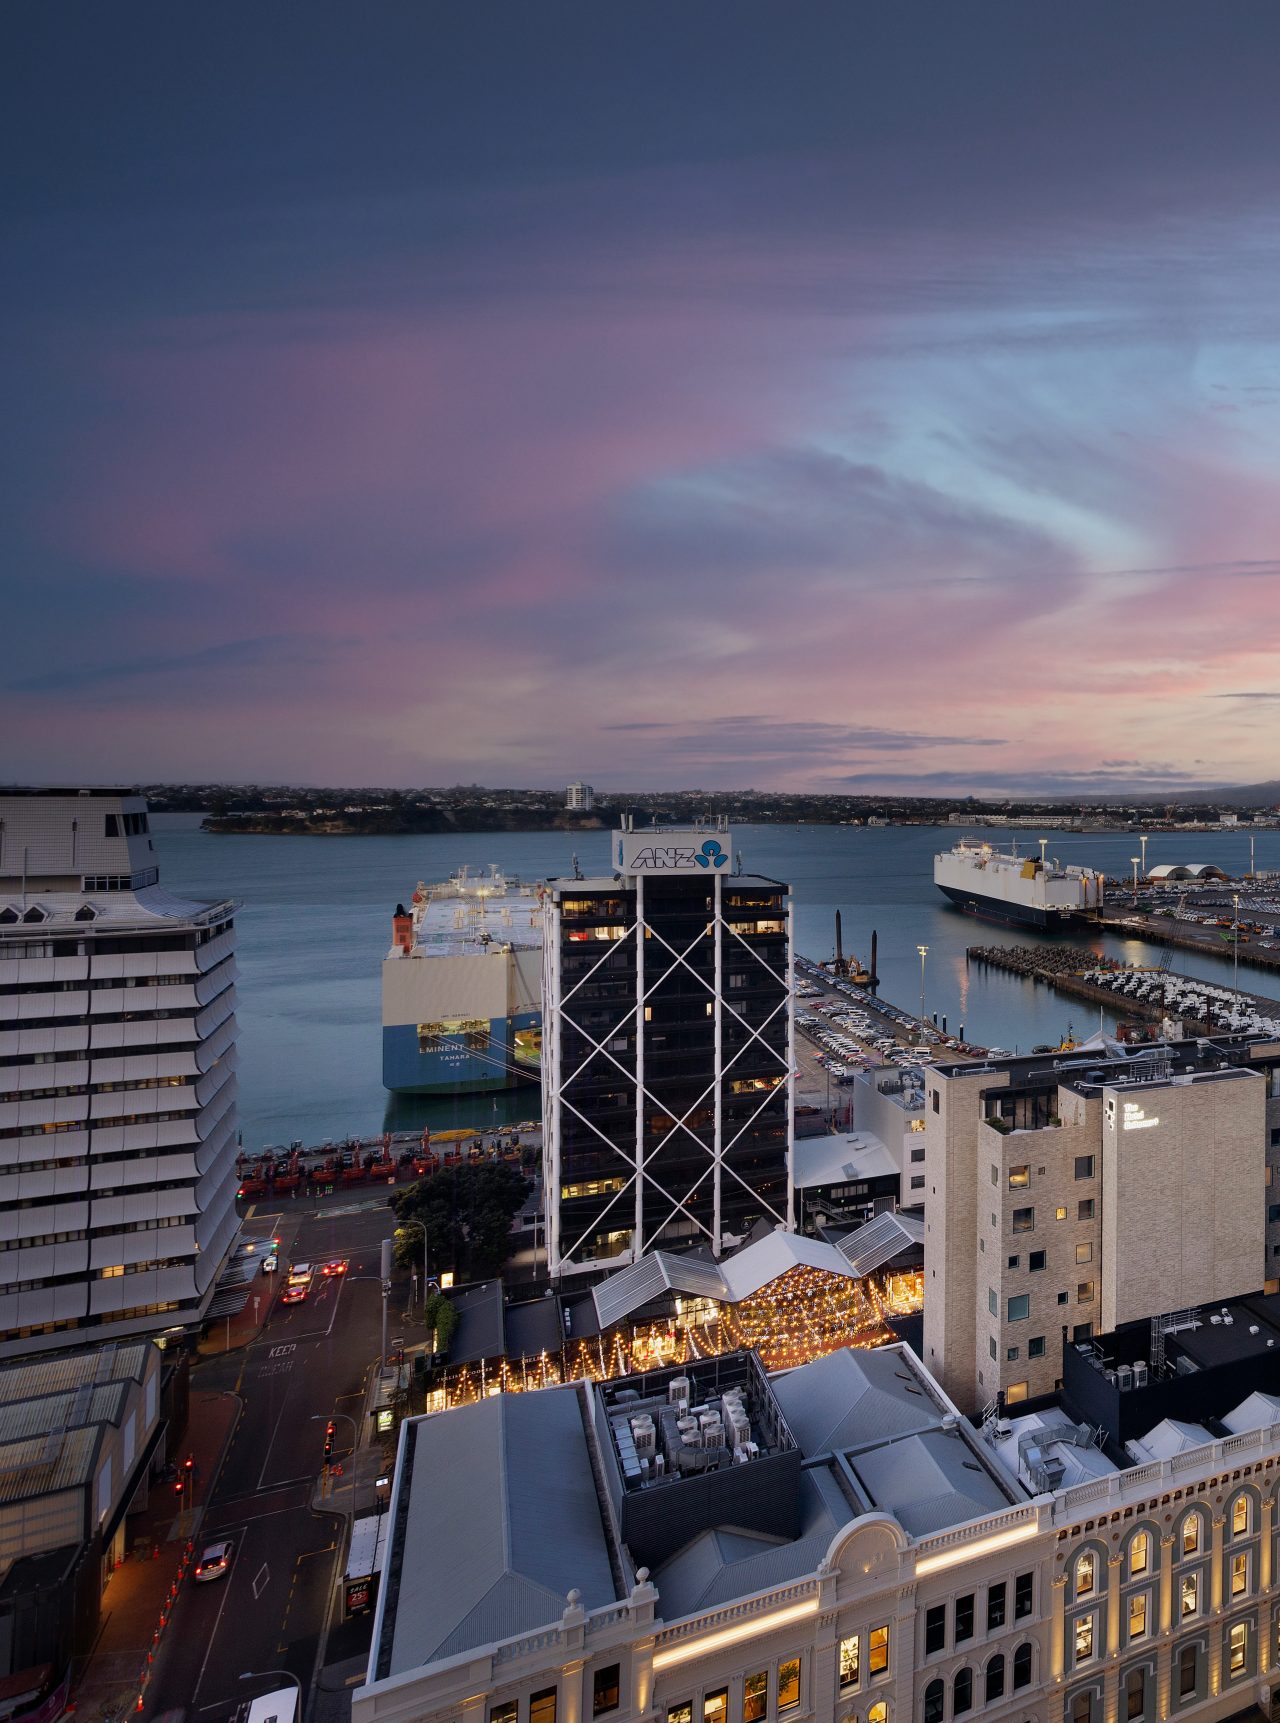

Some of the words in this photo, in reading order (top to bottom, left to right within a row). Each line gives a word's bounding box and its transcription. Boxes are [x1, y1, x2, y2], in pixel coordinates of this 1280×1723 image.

[630, 847, 697, 869] ANZ
[419, 1044, 464, 1054] EMINENT
[268, 1343, 297, 1359] KEEP
[349, 1583, 368, 1593] SALE
